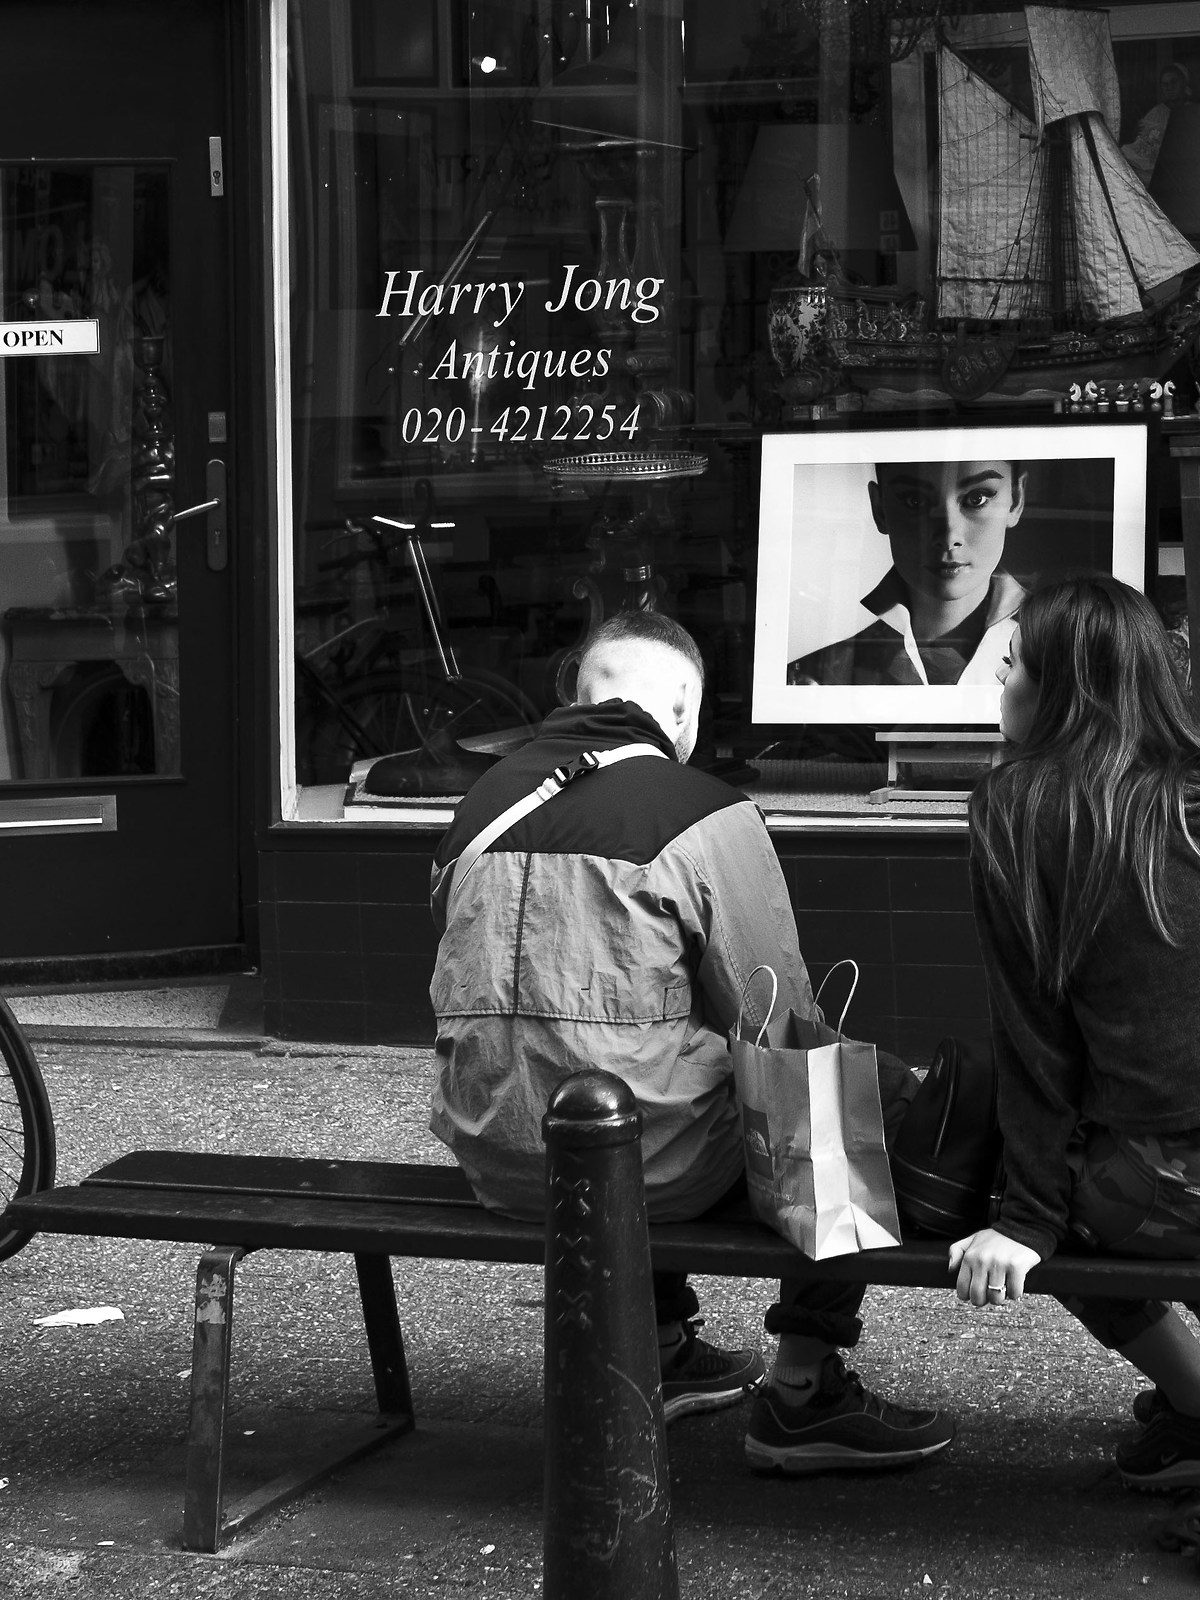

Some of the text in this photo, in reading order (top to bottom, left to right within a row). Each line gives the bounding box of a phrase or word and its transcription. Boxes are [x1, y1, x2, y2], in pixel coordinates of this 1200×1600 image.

[376, 264, 664, 328] Harry Jong
[3, 329, 64, 348] OPEN
[427, 339, 612, 390] Antiques
[402, 404, 641, 444] 020-4212254
